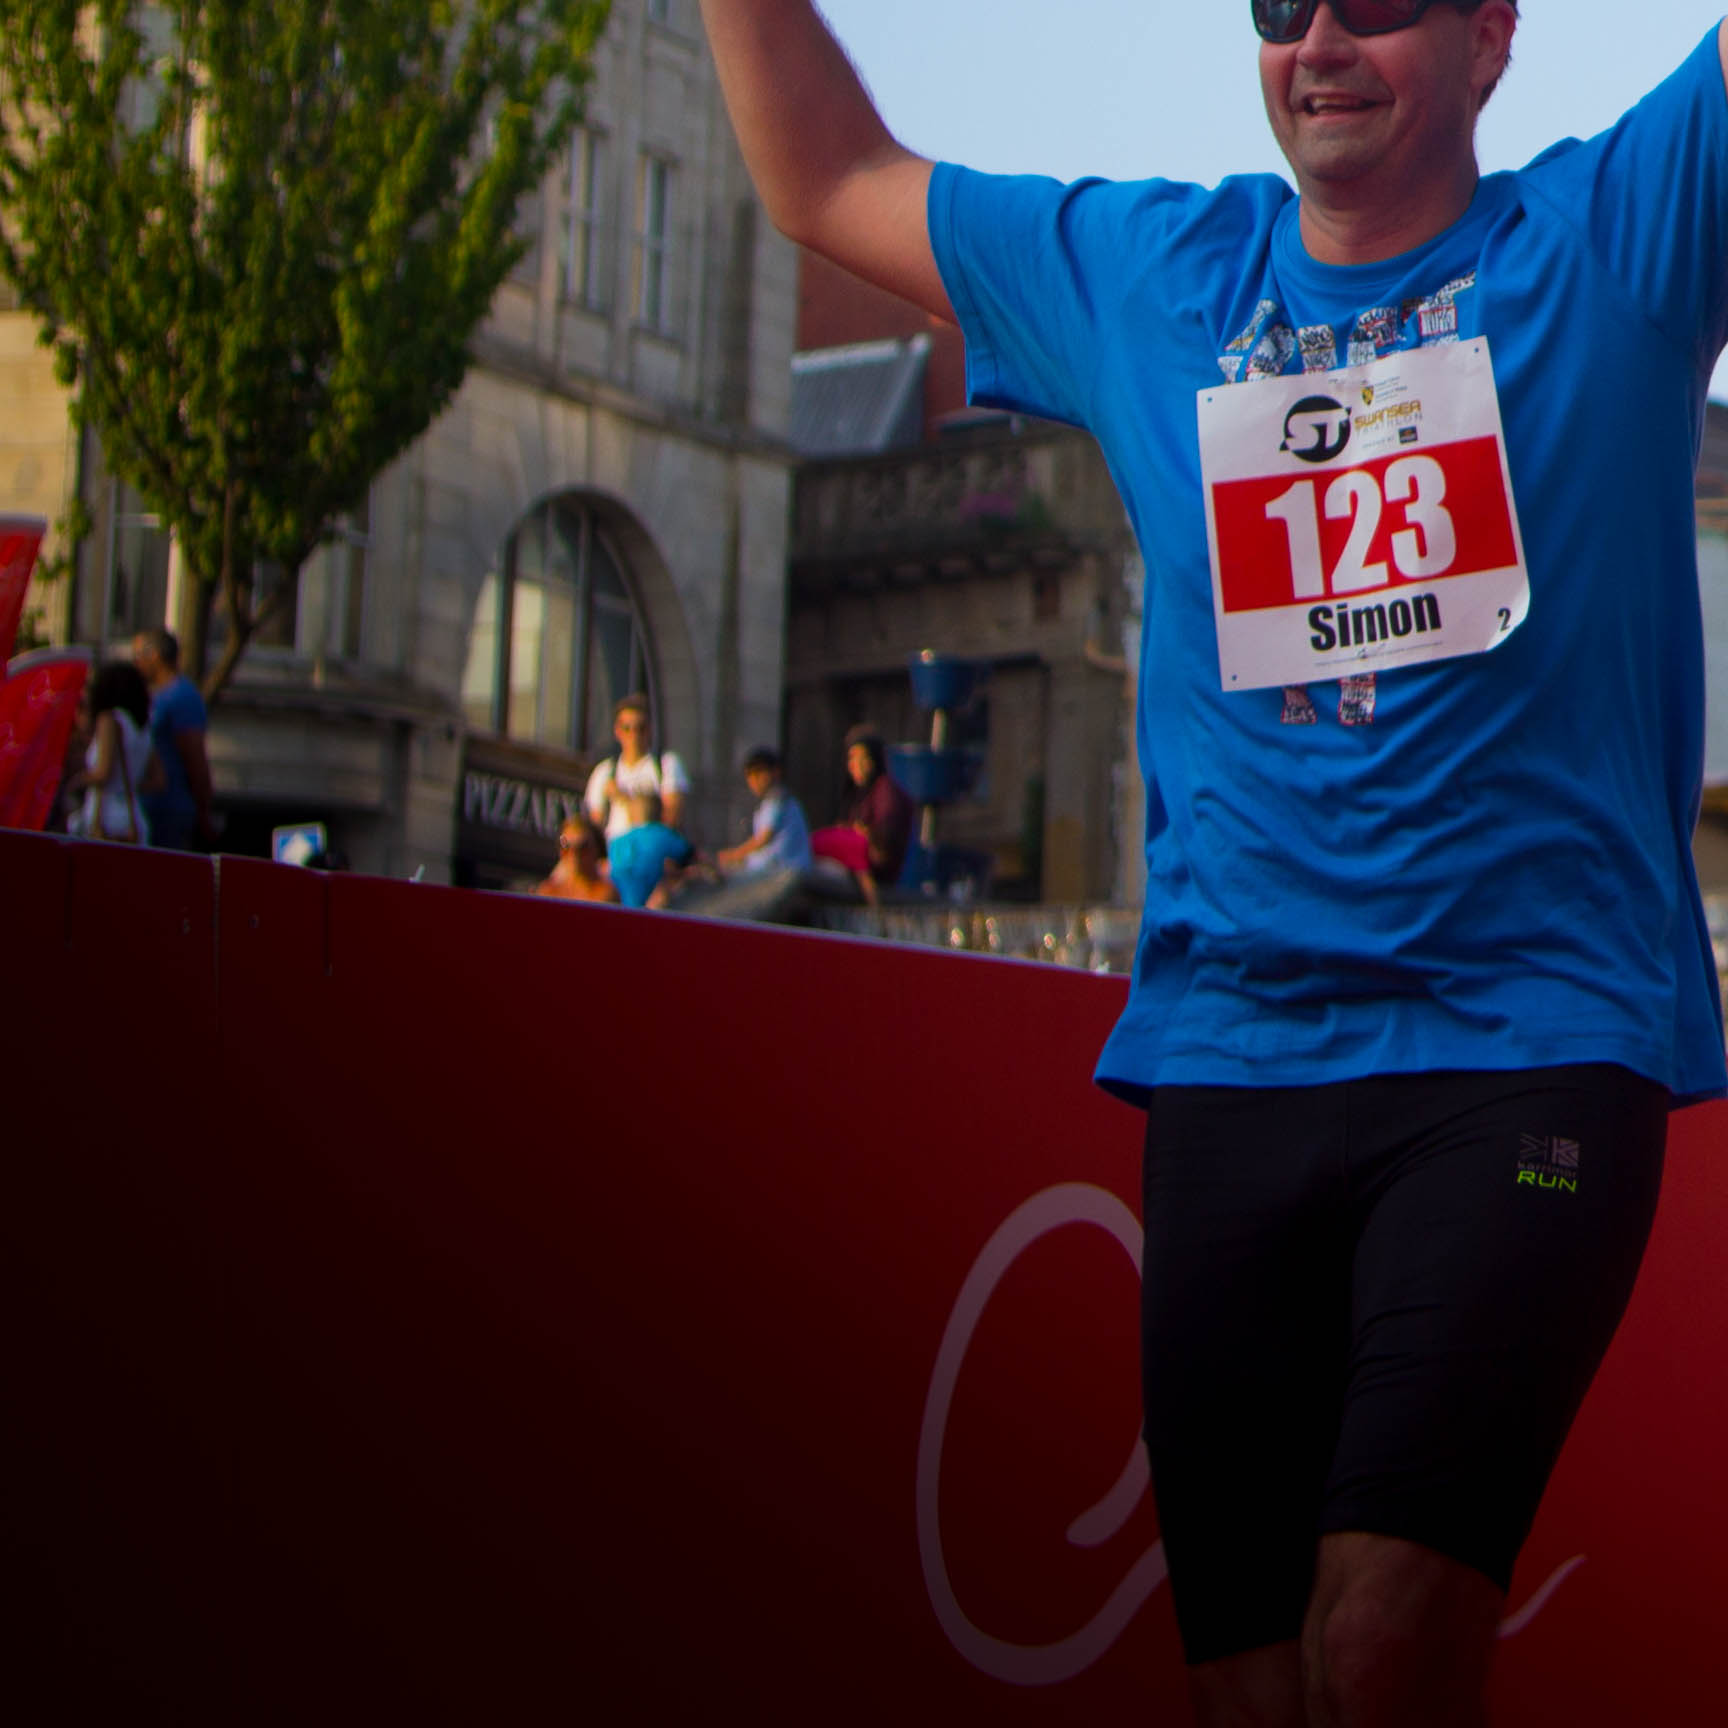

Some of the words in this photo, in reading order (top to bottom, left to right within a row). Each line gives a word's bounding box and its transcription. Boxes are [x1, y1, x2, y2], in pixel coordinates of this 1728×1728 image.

[1265, 455, 1456, 600] 123
[1307, 592, 1441, 652] Simon
[1498, 608, 1511, 632] 2
[1517, 1170, 1577, 1193] RUN
